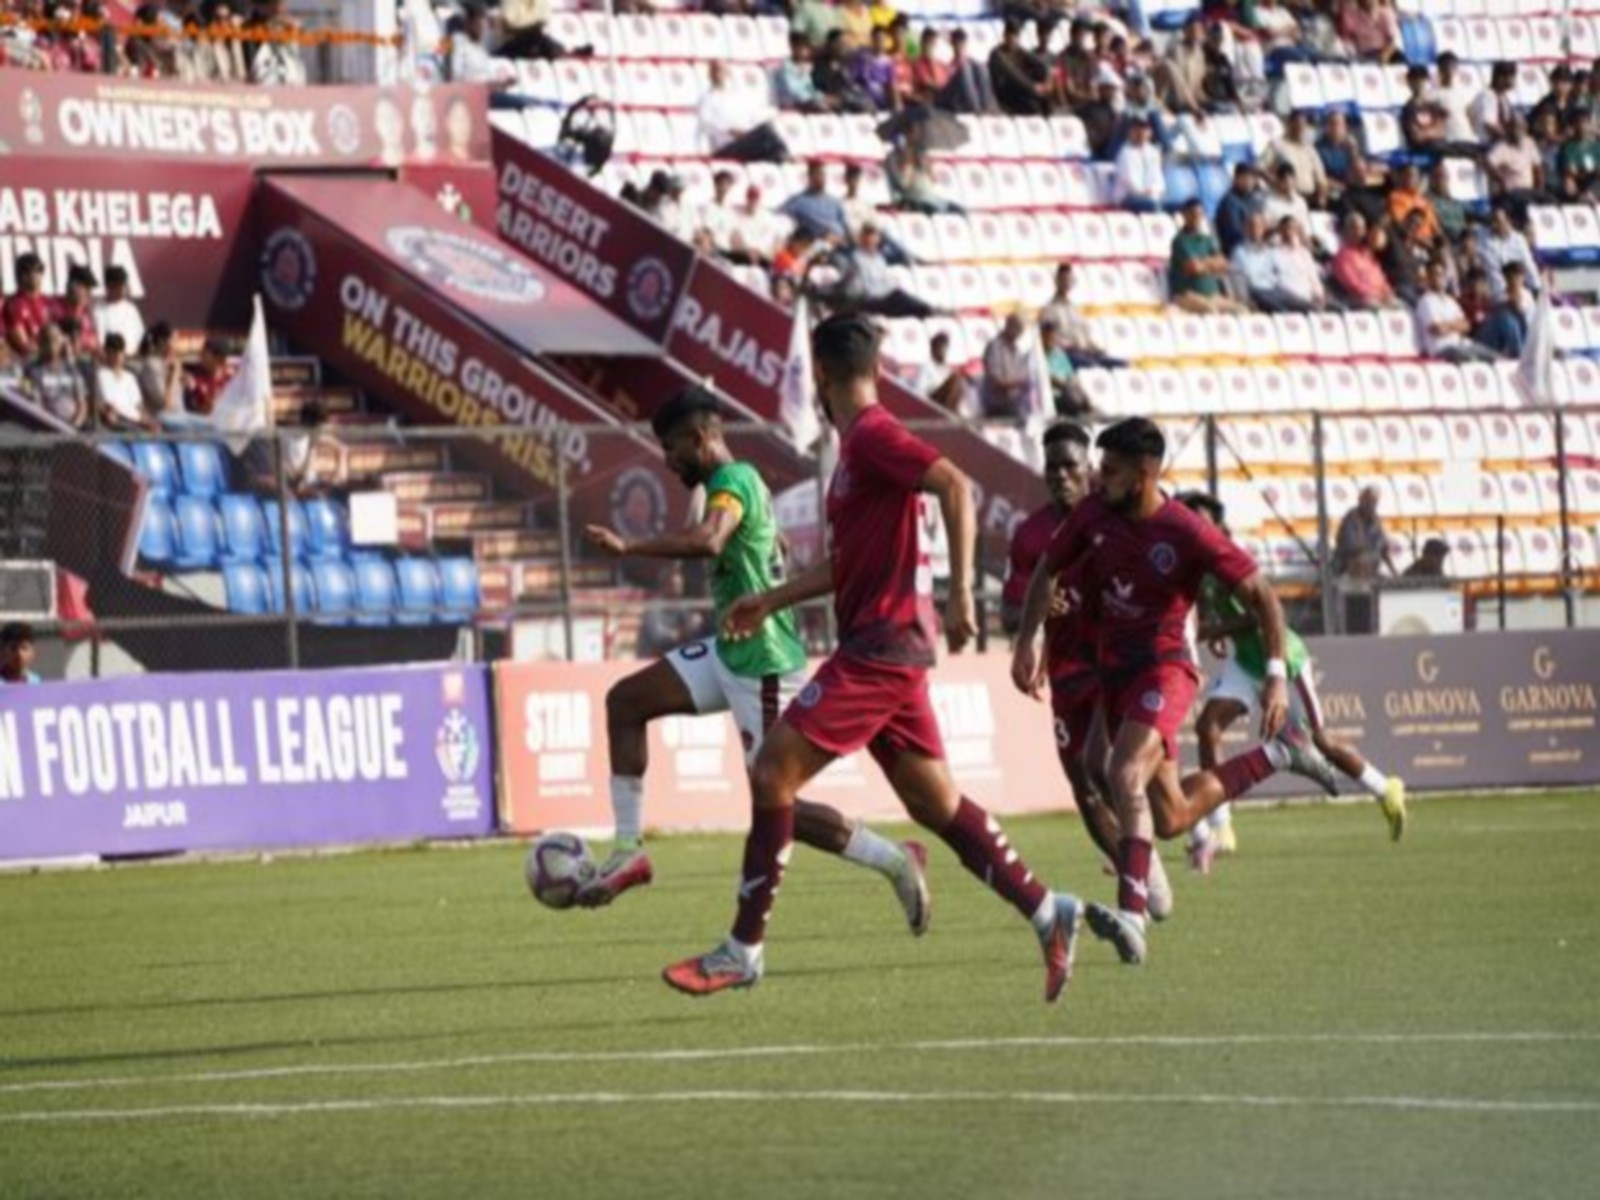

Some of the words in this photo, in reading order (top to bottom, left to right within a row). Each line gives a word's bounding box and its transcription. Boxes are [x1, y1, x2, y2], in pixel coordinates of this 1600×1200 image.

[58, 99, 239, 154] OWNER'S
[239, 107, 321, 155] BOX
[55, 189, 223, 238] KHELEGA
[501, 161, 609, 249] DESERT
[340, 275, 388, 328] ON
[393, 307, 459, 376] THIS
[673, 295, 787, 388] RAJAS
[502, 432, 557, 481] RIS
[524, 689, 592, 752] STAR
[1384, 687, 1482, 719] GARNOVA
[1500, 682, 1597, 713] GARNOVA
[33, 698, 248, 797] FOOTBALL
[253, 692, 408, 784] LEAGUE
[122, 800, 189, 829] JAIPUR
